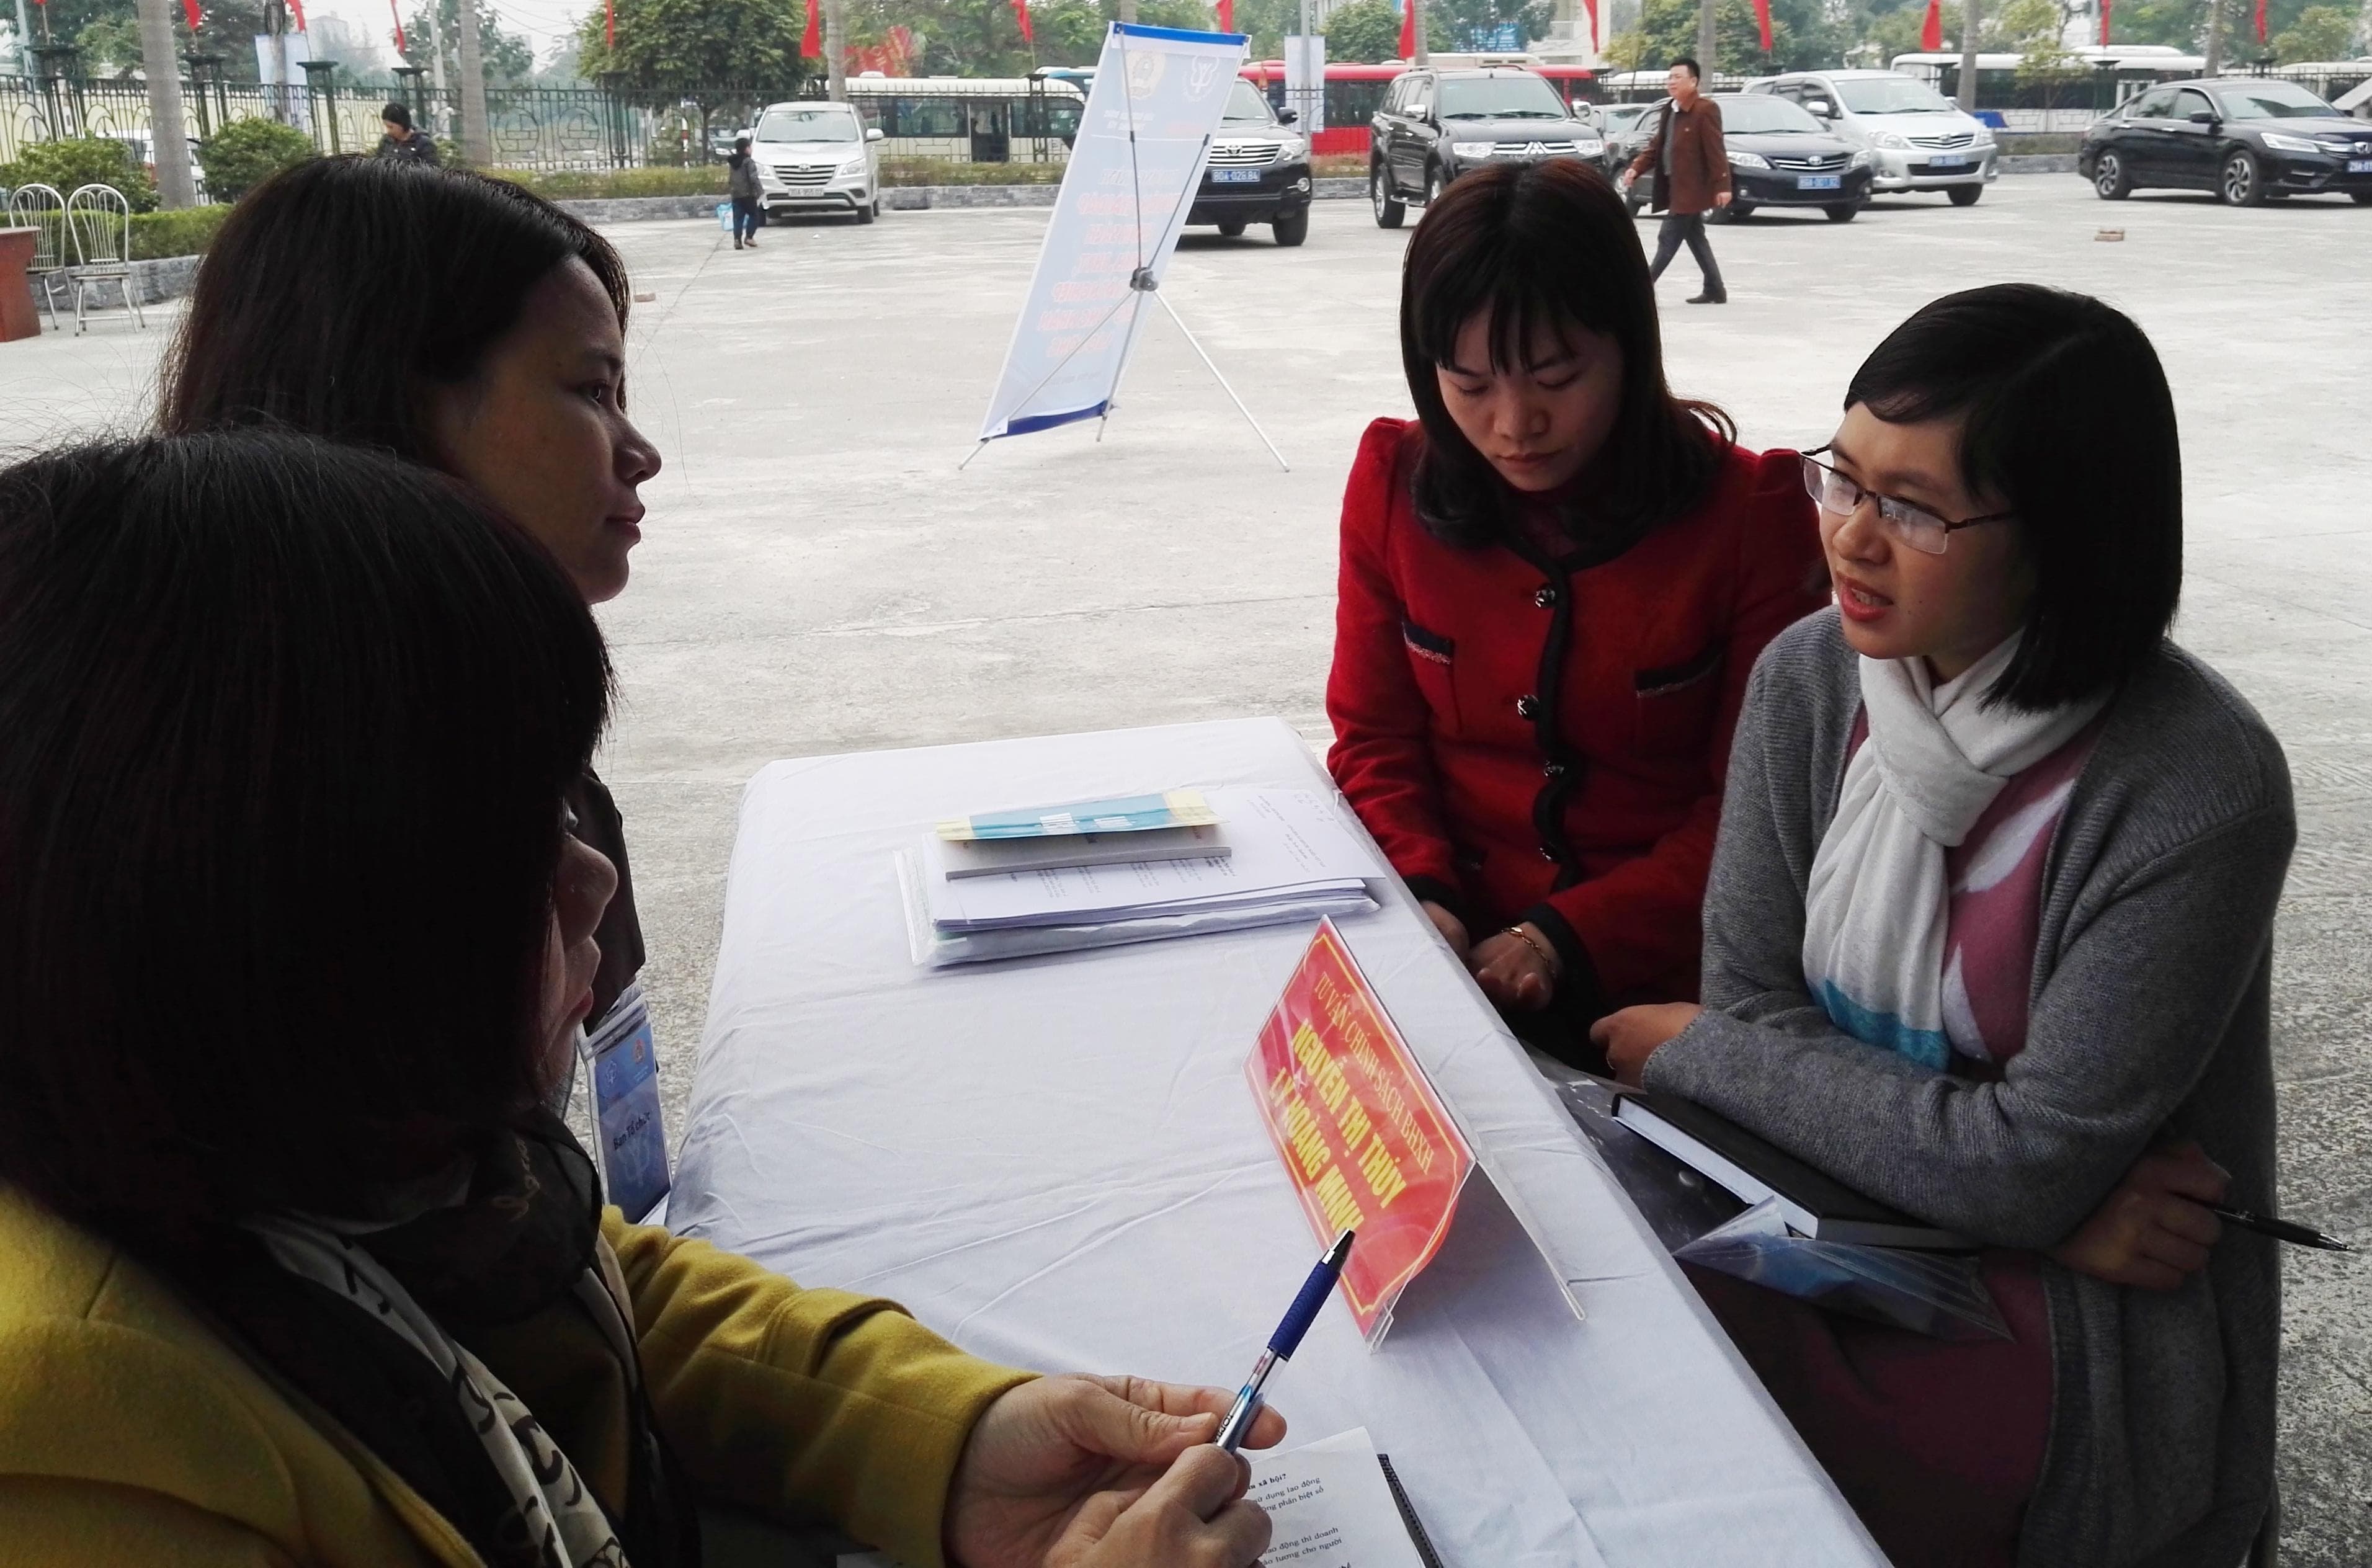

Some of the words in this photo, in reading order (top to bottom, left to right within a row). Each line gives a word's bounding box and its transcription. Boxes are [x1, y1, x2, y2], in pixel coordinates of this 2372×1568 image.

[1291, 1018, 1350, 1115] NGUYỄN
[1337, 1095, 1372, 1157] THỊ
[1325, 988, 1352, 1031] VẤN
[1345, 1020, 1380, 1080] CHÍNH
[1374, 1067, 1406, 1125] SÁCH
[1399, 1110, 1435, 1175] BHXH
[1314, 1164, 1365, 1237] MINH
[1265, 1489, 1285, 1500] dụng
[1286, 1485, 1299, 1494] lao
[1301, 1477, 1321, 1488] động
[1278, 1497, 1298, 1508] phân
[1298, 1491, 1314, 1501] biệt
[1279, 1539, 1300, 1549] động
[1314, 1526, 1339, 1540] doanh
[1302, 1546, 1317, 1555] cho
[1319, 1536, 1342, 1550] người
